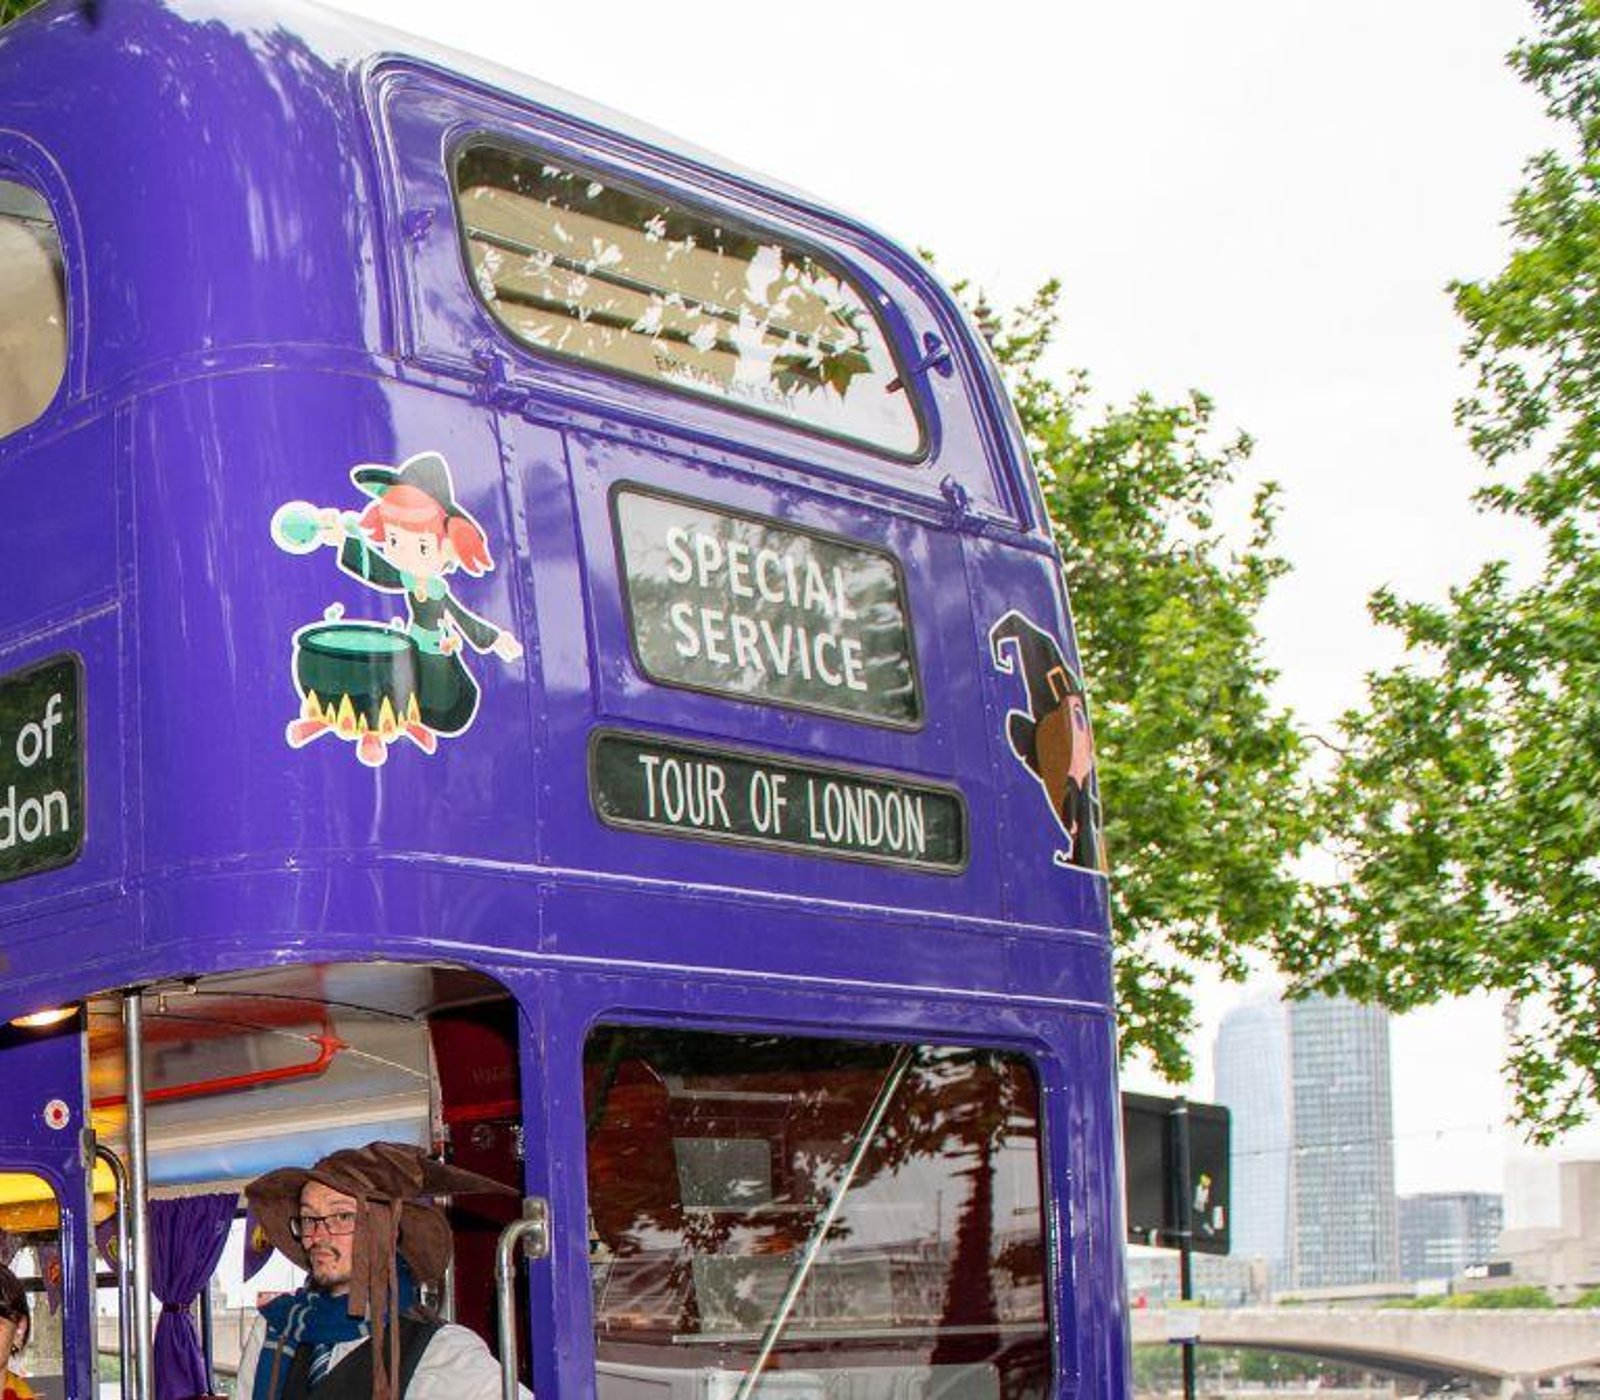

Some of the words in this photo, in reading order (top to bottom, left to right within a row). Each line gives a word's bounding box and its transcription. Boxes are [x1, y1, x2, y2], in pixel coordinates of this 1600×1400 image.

[667, 527, 857, 620] SPECIAL
[670, 602, 868, 691] SERVICE
[16, 693, 62, 768] of
[639, 754, 732, 828] TOUR
[750, 769, 788, 834] OF
[808, 778, 925, 853] LONDON
